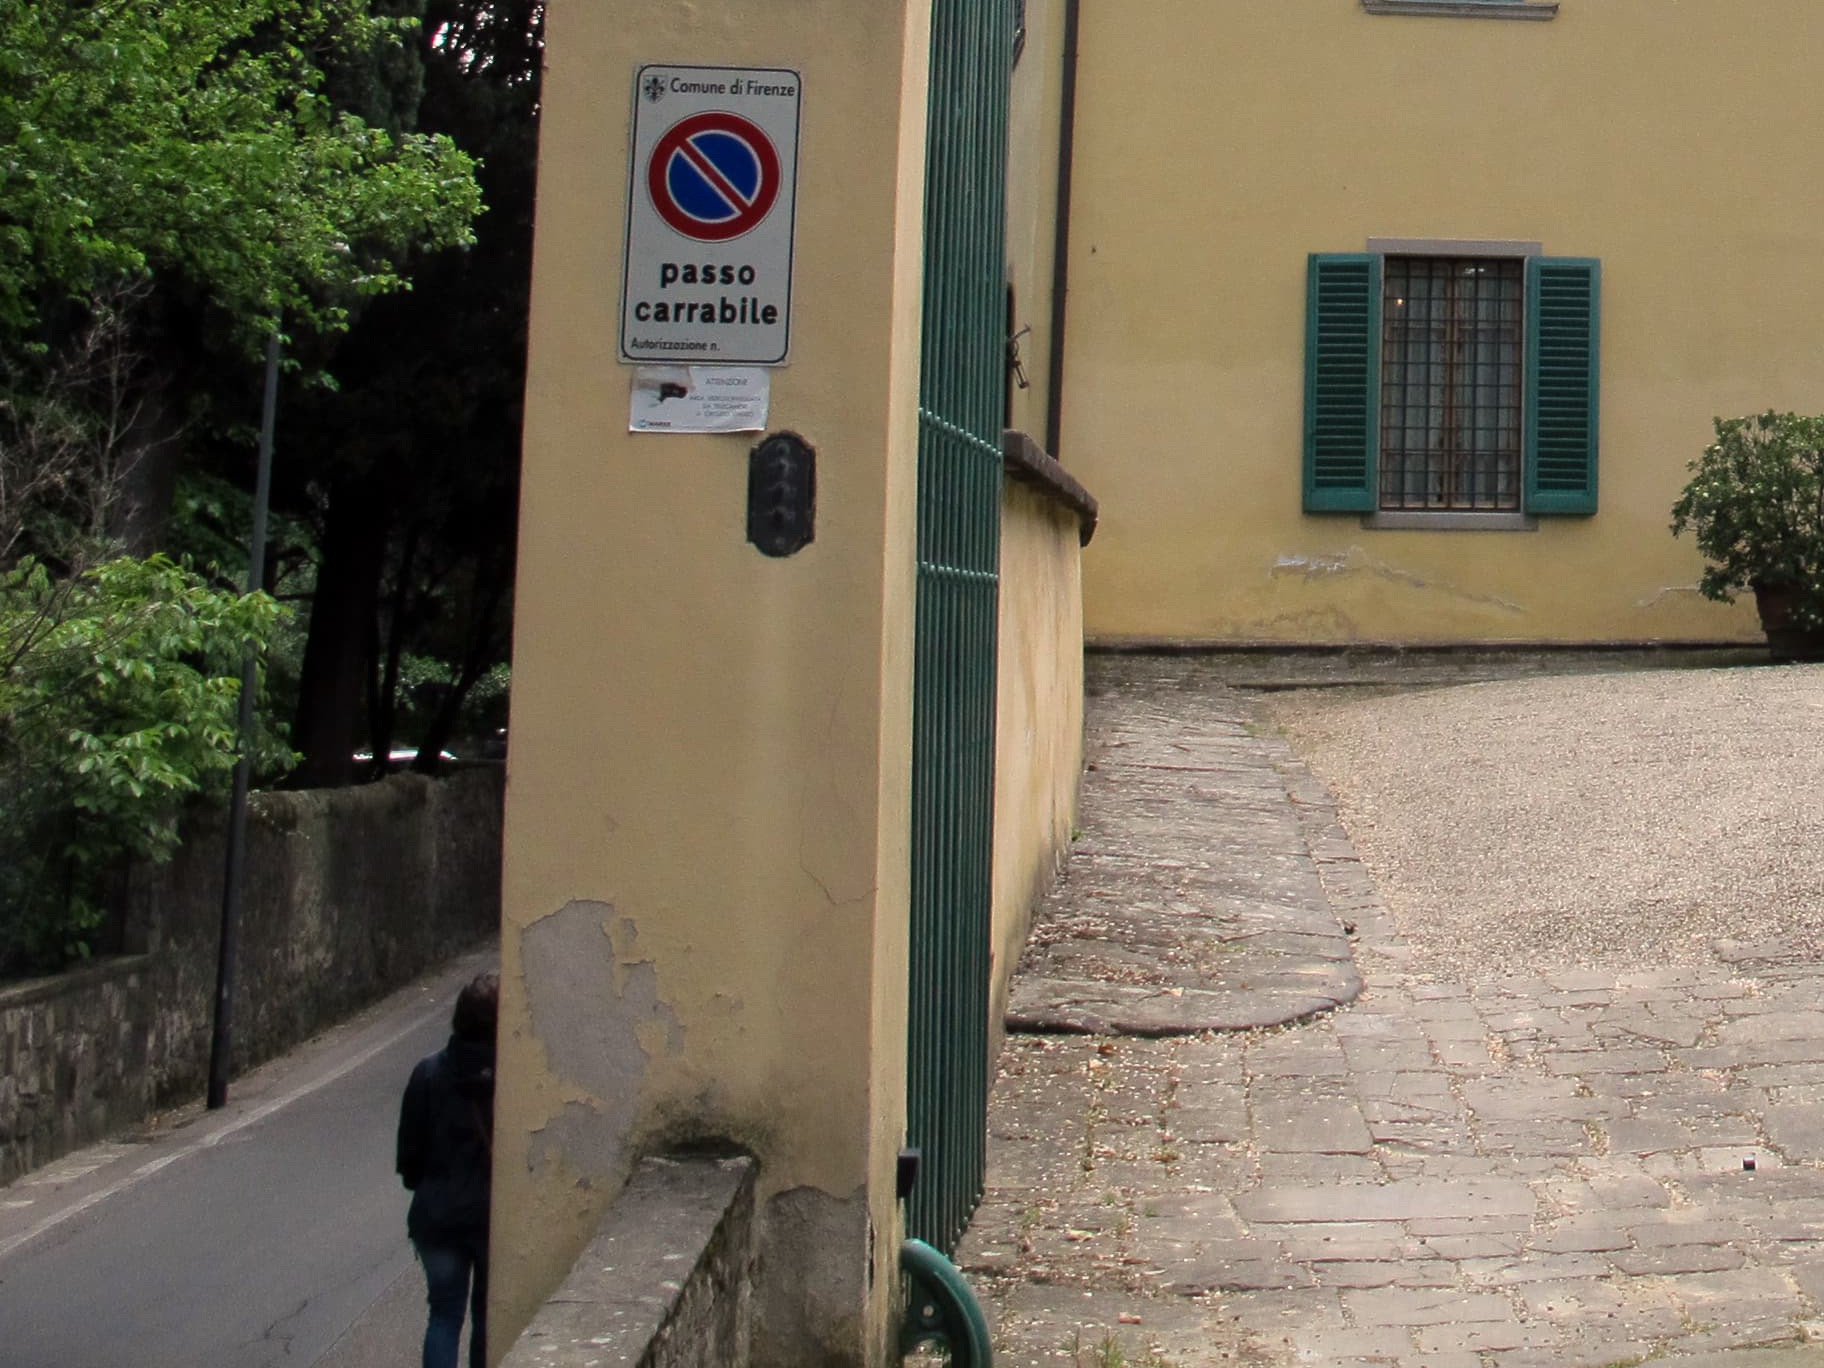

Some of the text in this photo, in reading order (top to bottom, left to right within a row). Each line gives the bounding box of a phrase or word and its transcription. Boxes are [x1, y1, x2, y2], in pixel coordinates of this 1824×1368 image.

[670, 77, 796, 97] Comune di Firenze
[661, 263, 755, 288] passo
[635, 296, 778, 324] carrabile
[631, 337, 721, 351] Autorizzazione n.
